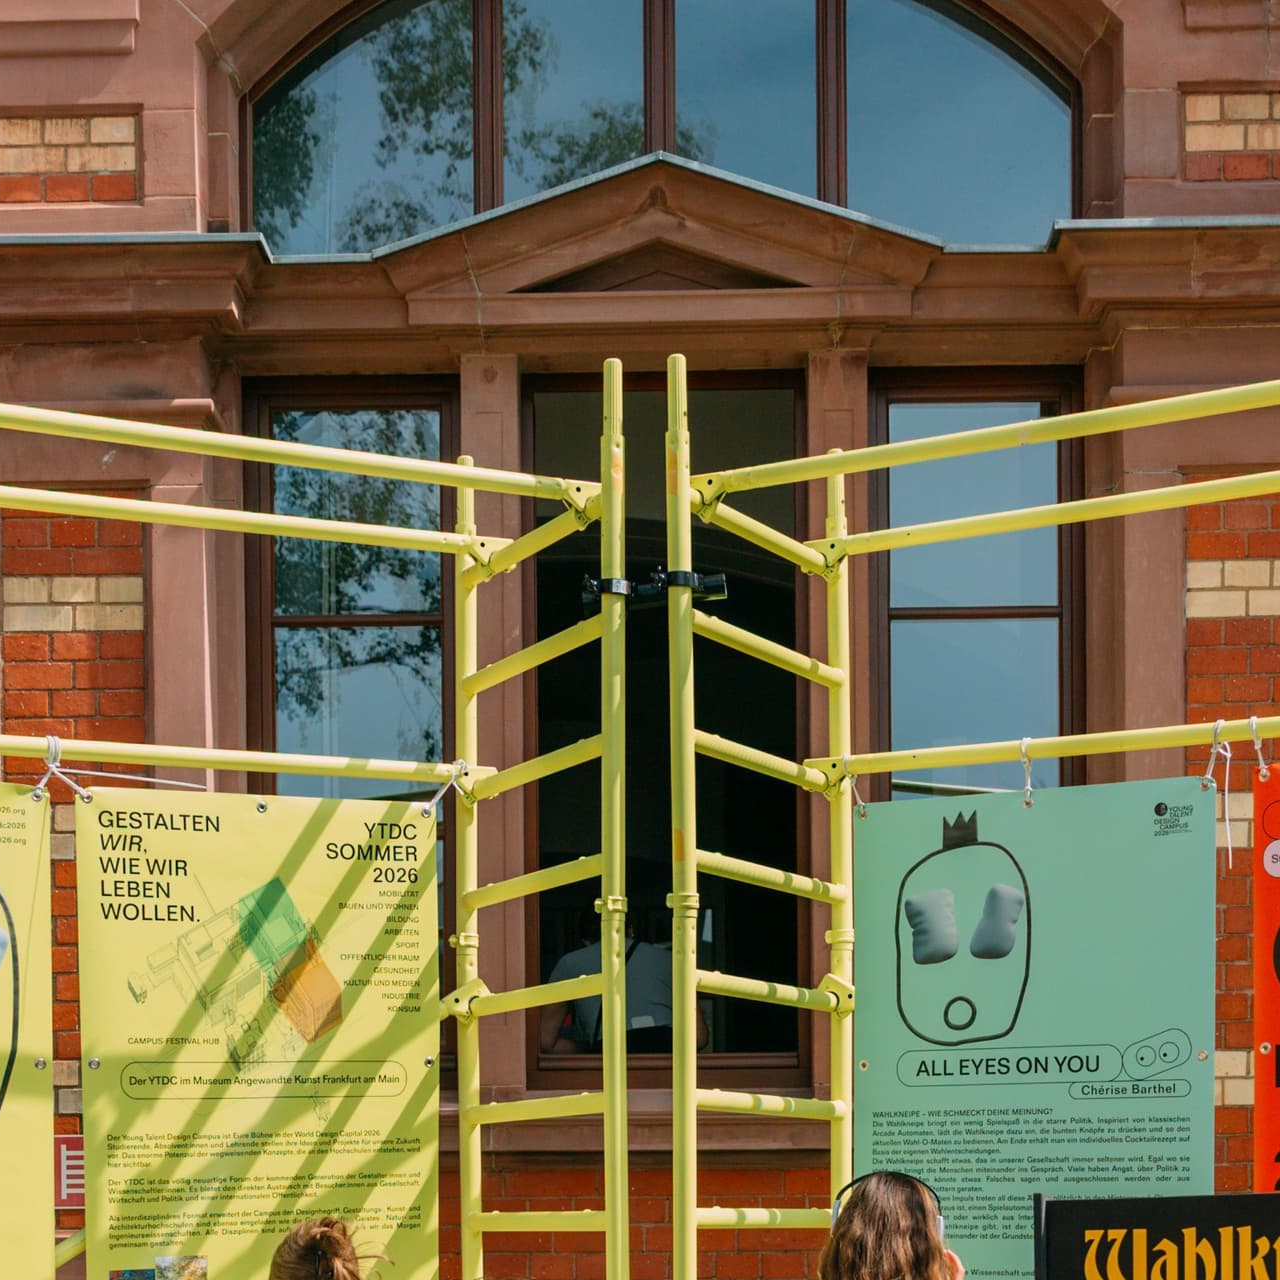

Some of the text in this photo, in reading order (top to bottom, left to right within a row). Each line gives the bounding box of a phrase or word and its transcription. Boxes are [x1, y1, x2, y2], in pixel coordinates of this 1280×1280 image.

[98, 810, 220, 833] GESTALTEN
[363, 822, 417, 841] YTDC
[100, 833, 147, 854] WIR,
[326, 842, 418, 862] SOMMER
[99, 856, 188, 877] WIE WIR
[373, 867, 419, 884] 2026
[100, 879, 171, 899] LEBEN
[100, 902, 200, 923] WOLLEN.
[916, 1055, 1100, 1077] ALL EYES ON YOU
[129, 1076, 147, 1086] Der
[148, 1075, 177, 1086] YTDC
[180, 1077, 191, 1085] im
[193, 1076, 232, 1086] Museum
[233, 1076, 292, 1087] Angewandte
[294, 1074, 321, 1084] Kunst
[322, 1074, 361, 1084] Frankfurt
[378, 1074, 400, 1083] Main
[1081, 1082, 1176, 1096] Chérise Barthel
